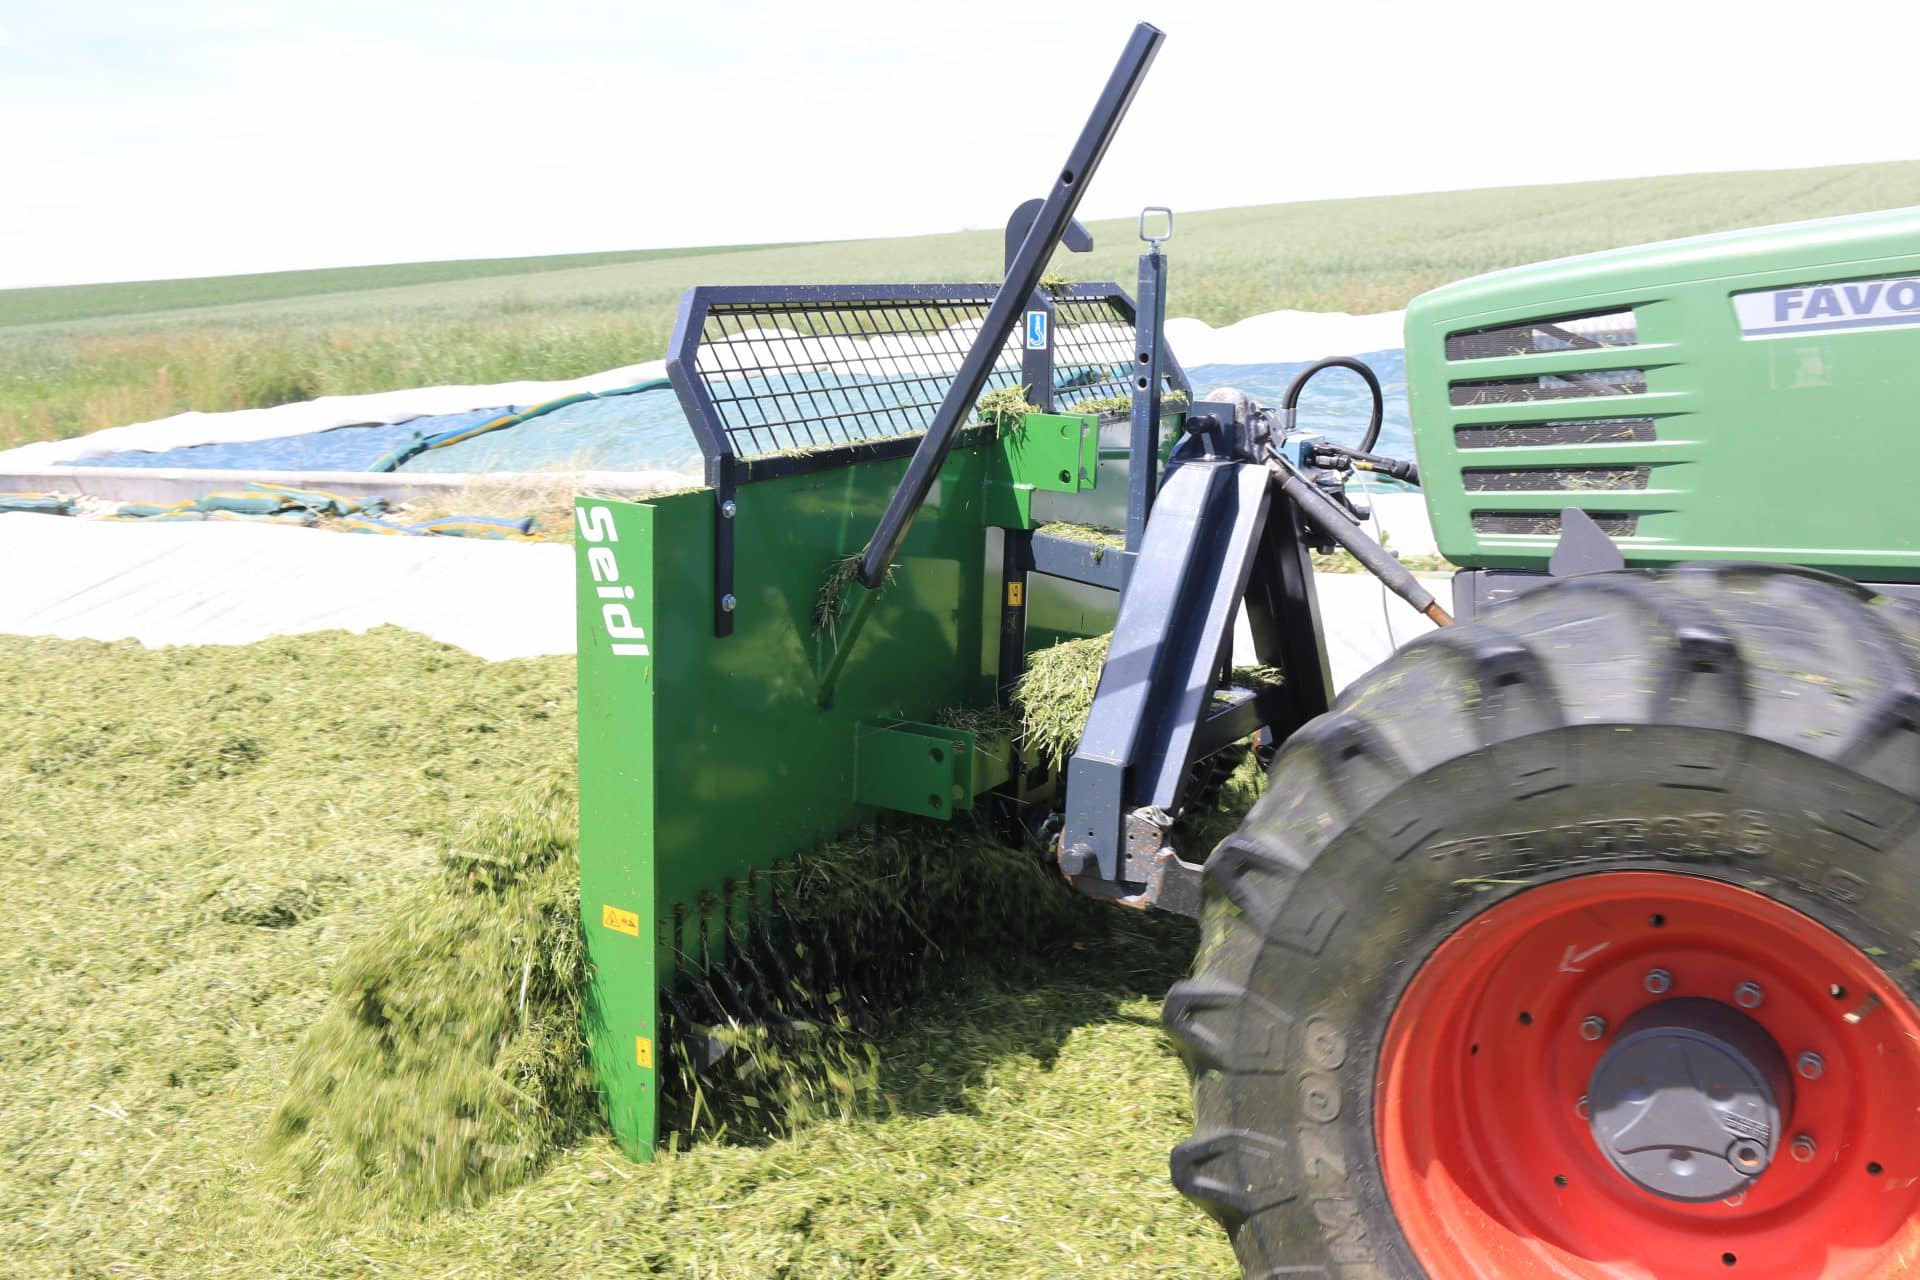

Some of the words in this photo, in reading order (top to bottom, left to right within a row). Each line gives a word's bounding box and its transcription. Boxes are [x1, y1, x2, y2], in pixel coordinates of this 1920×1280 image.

[1774, 281, 1920, 321] FAVO
[576, 506, 649, 656] Seidl
[1298, 1013, 1378, 1279] M700
